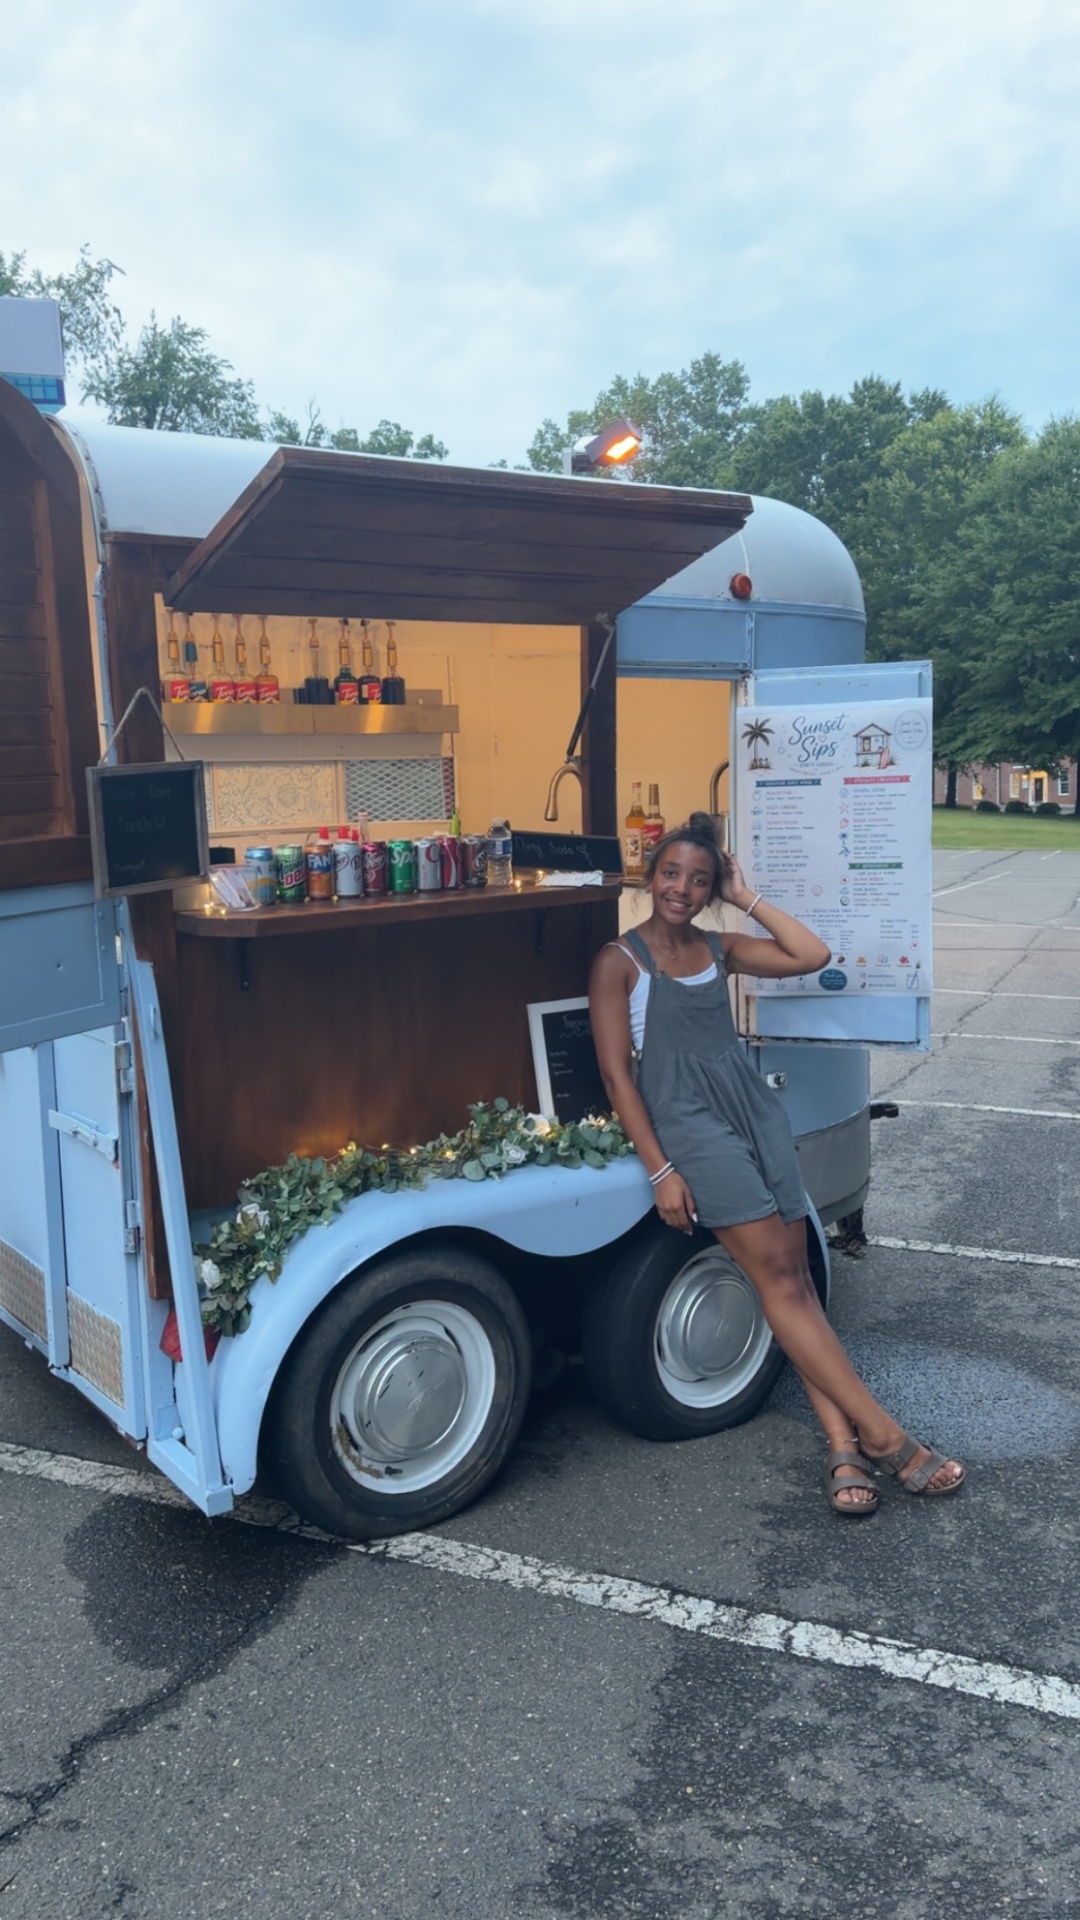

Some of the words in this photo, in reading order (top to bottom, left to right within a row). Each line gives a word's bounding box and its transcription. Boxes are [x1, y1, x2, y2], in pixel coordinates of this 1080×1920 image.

[788, 713, 849, 745] Sunset
[797, 735, 840, 762] Sips
[307, 852, 332, 868] FAN
